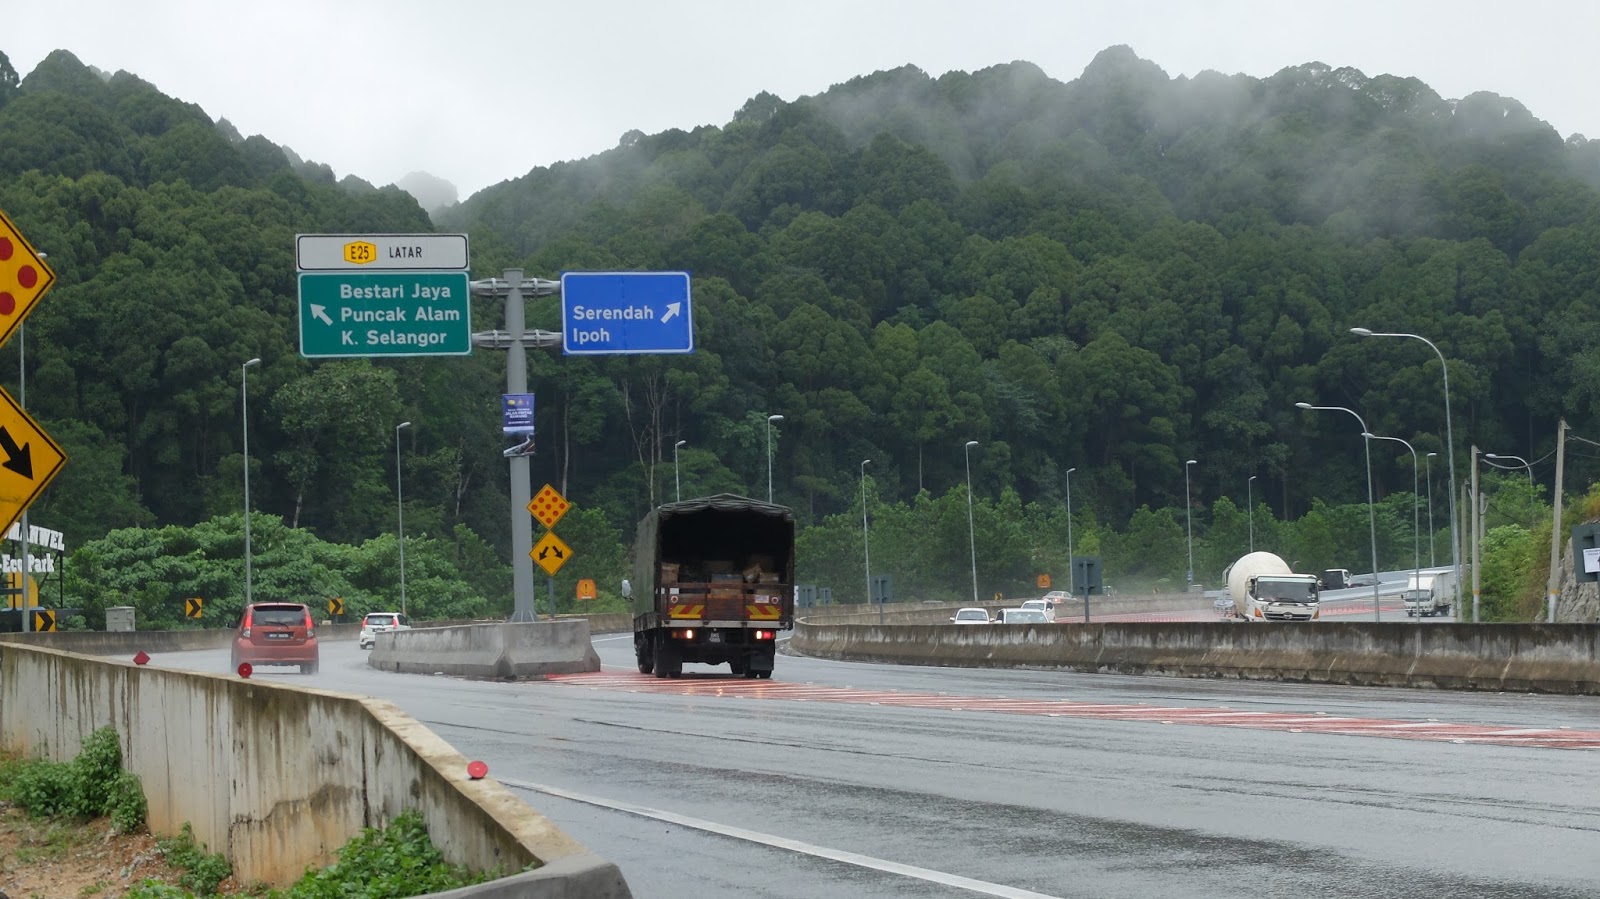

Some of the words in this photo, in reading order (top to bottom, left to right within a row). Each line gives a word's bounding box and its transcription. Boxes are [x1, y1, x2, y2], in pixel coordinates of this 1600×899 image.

[350, 246, 370, 260] E25
[389, 246, 422, 258] LATAR
[340, 284, 404, 298] Bestari
[412, 283, 451, 300] Jaya
[341, 306, 406, 322] Puncak
[415, 306, 460, 321] Alam
[573, 305, 654, 320] Serendah
[342, 330, 358, 345] K.
[366, 330, 447, 346] Selangor
[573, 328, 610, 344] Ipoh
[28, 553, 54, 573] Park
